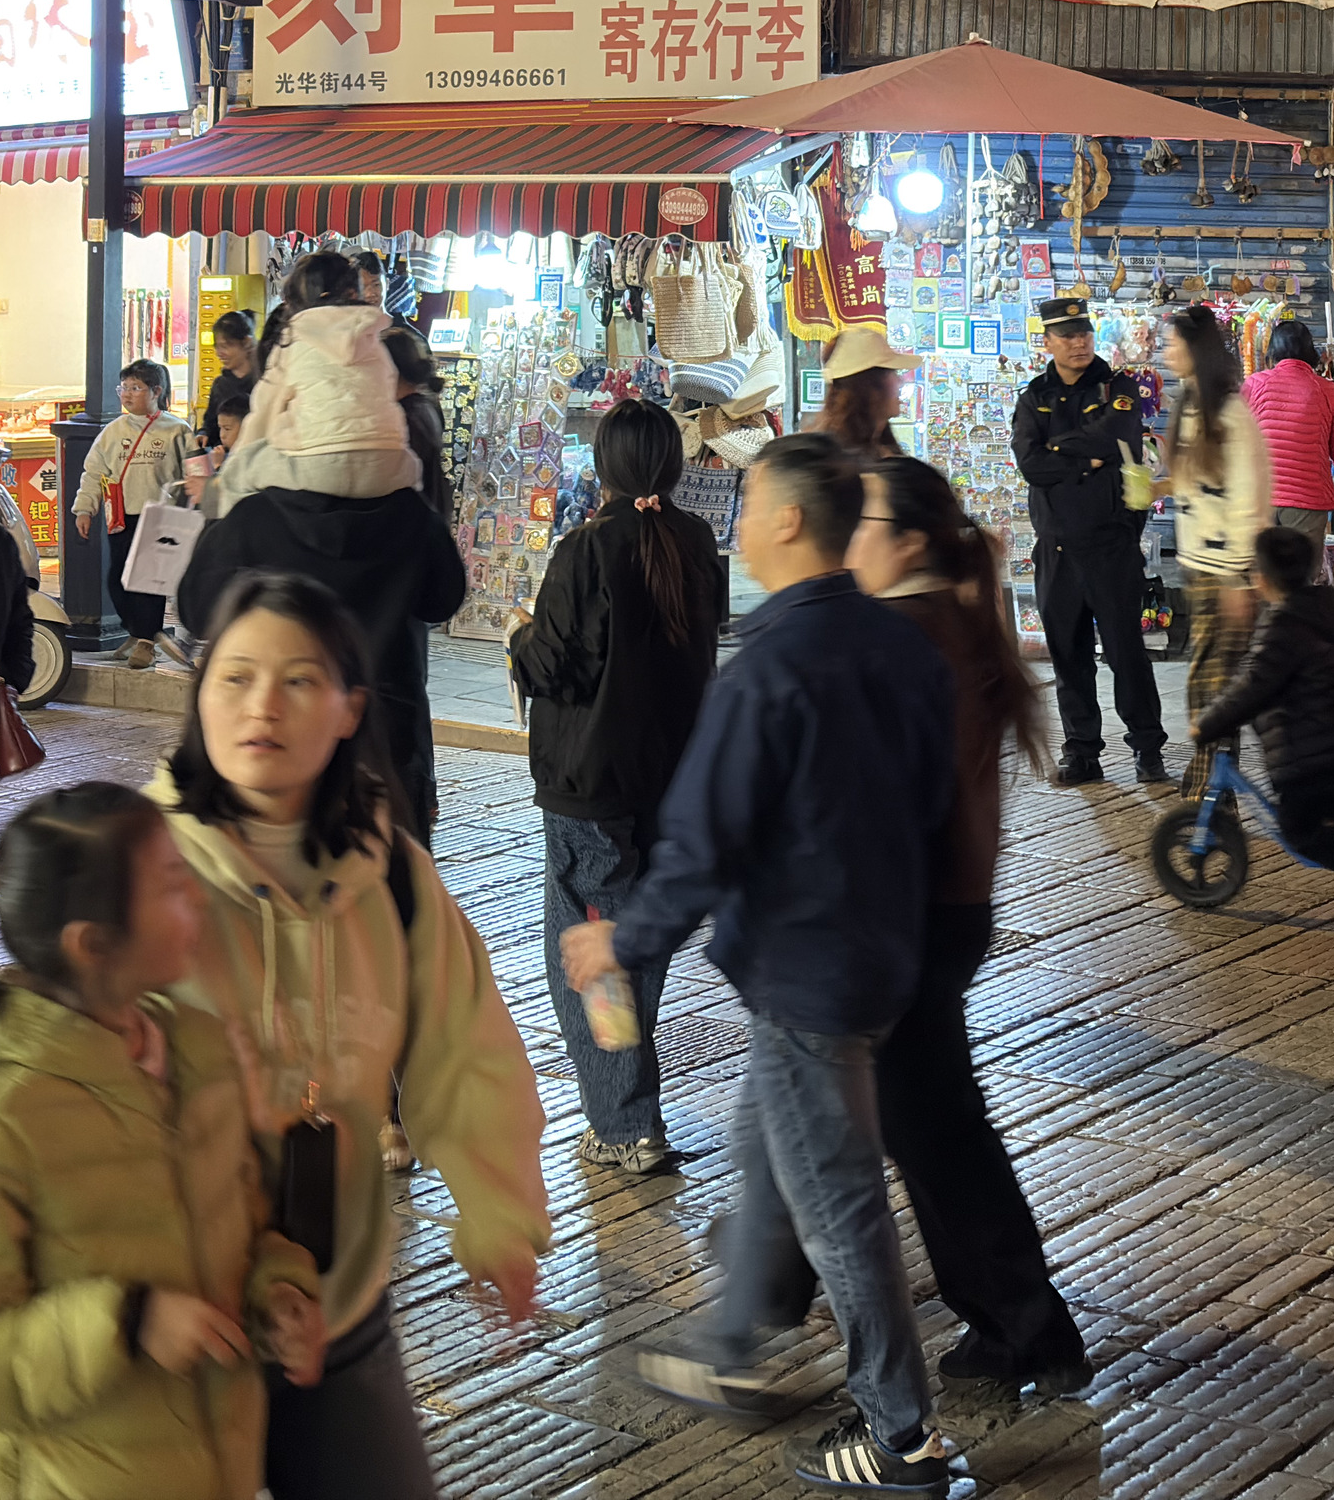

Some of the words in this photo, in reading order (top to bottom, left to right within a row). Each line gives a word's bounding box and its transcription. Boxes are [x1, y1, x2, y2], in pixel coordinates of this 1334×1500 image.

[274, 71, 388, 94] 光华街44号
[425, 67, 567, 90] 13099466661
[1, 463, 17, 487] 收
